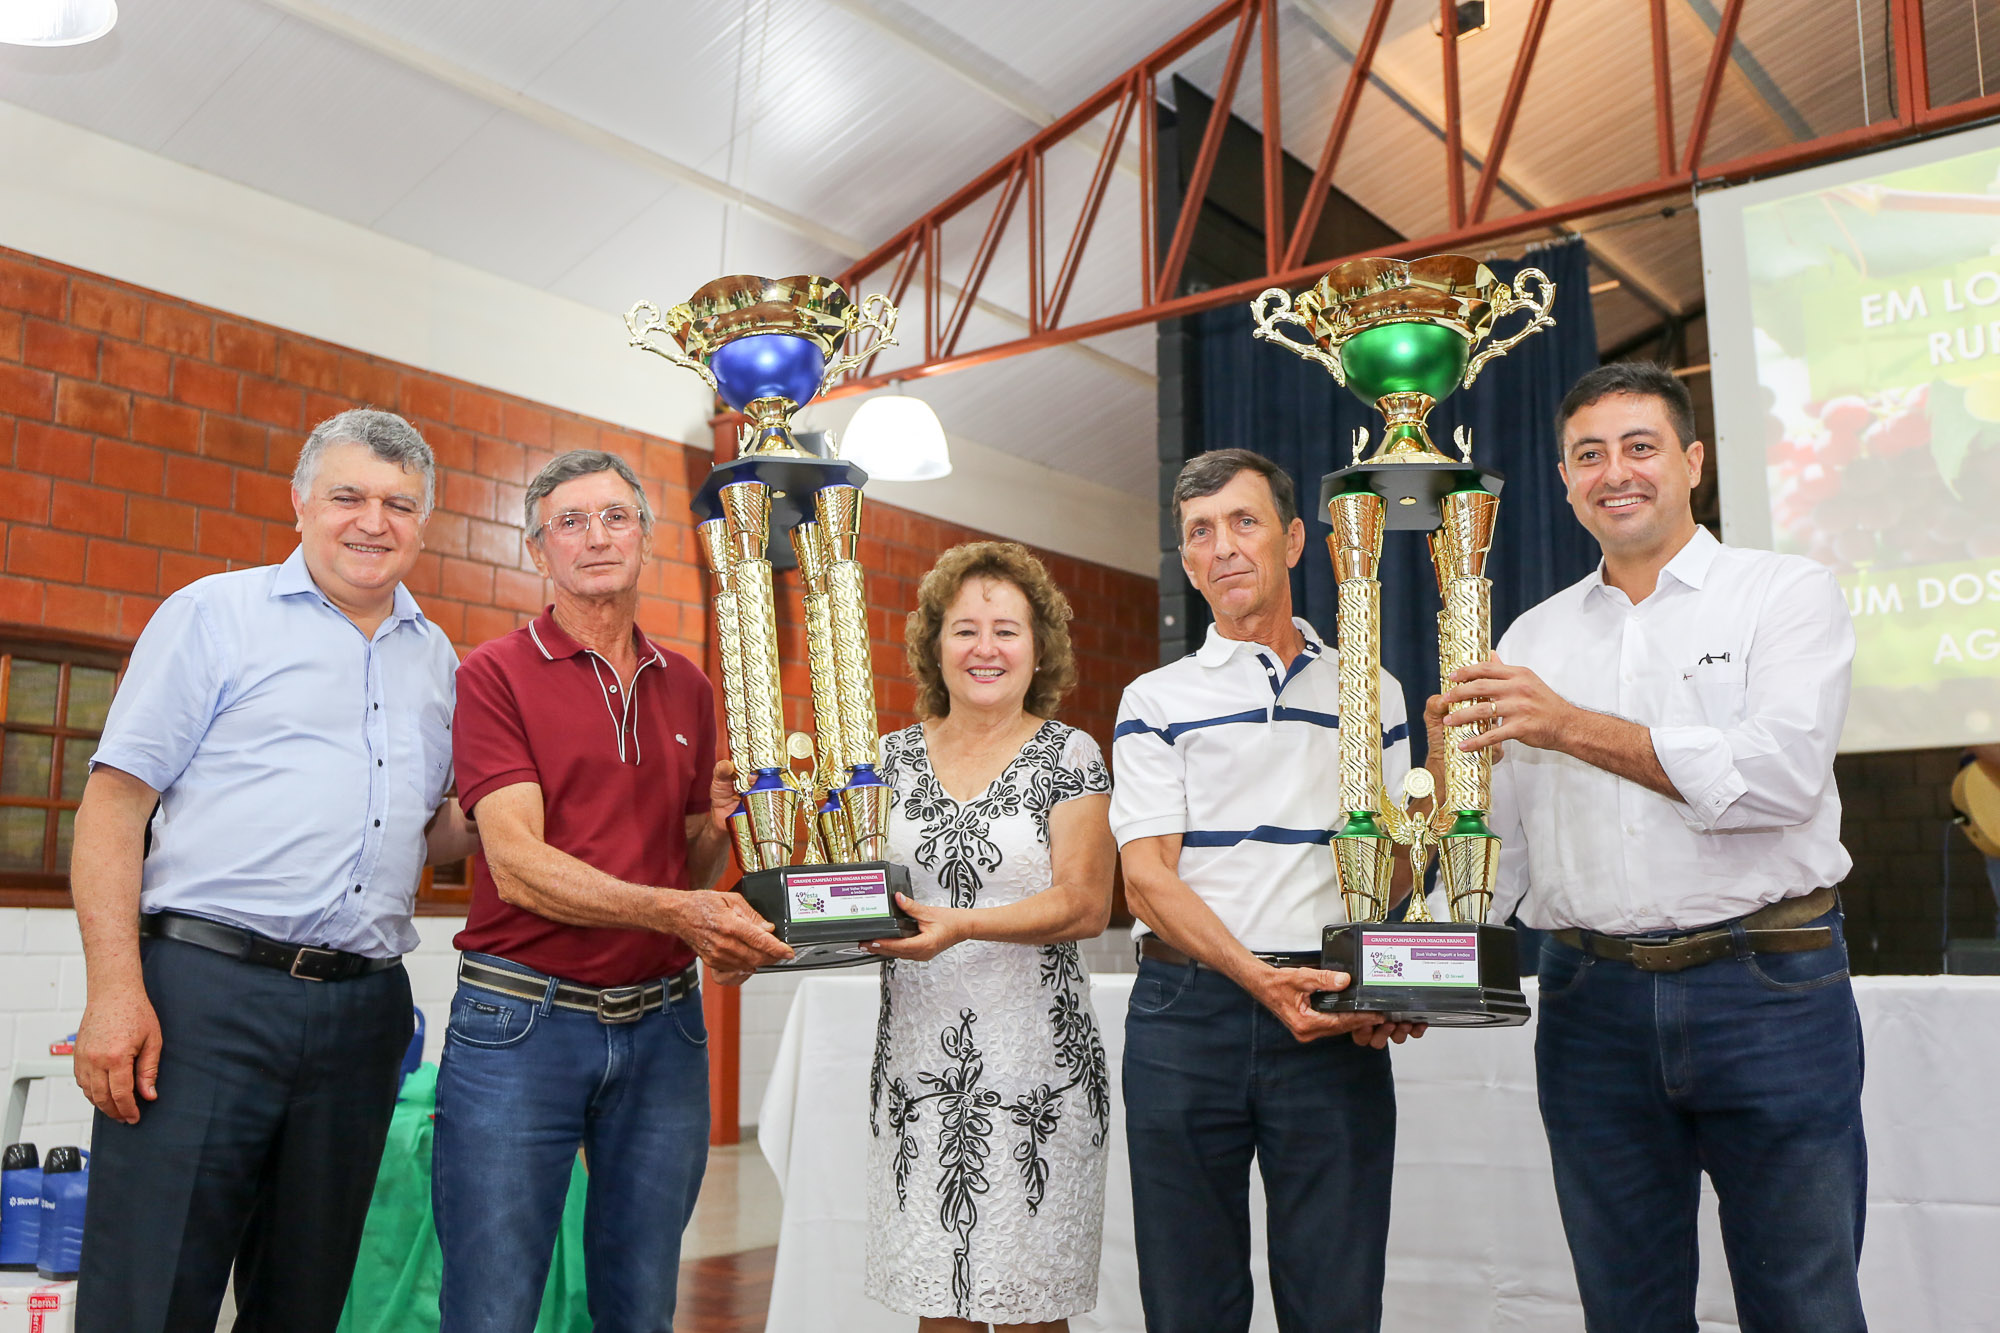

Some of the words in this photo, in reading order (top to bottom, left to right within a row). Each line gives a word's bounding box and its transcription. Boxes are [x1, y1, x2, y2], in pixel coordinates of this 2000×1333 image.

[1861, 285, 1930, 328] EM
[1943, 271, 2000, 313] LO
[1840, 582, 1904, 617] UM
[1917, 569, 2000, 609] DOS
[1932, 629, 2000, 665] AG
[31, 1298, 57, 1308] Berna
